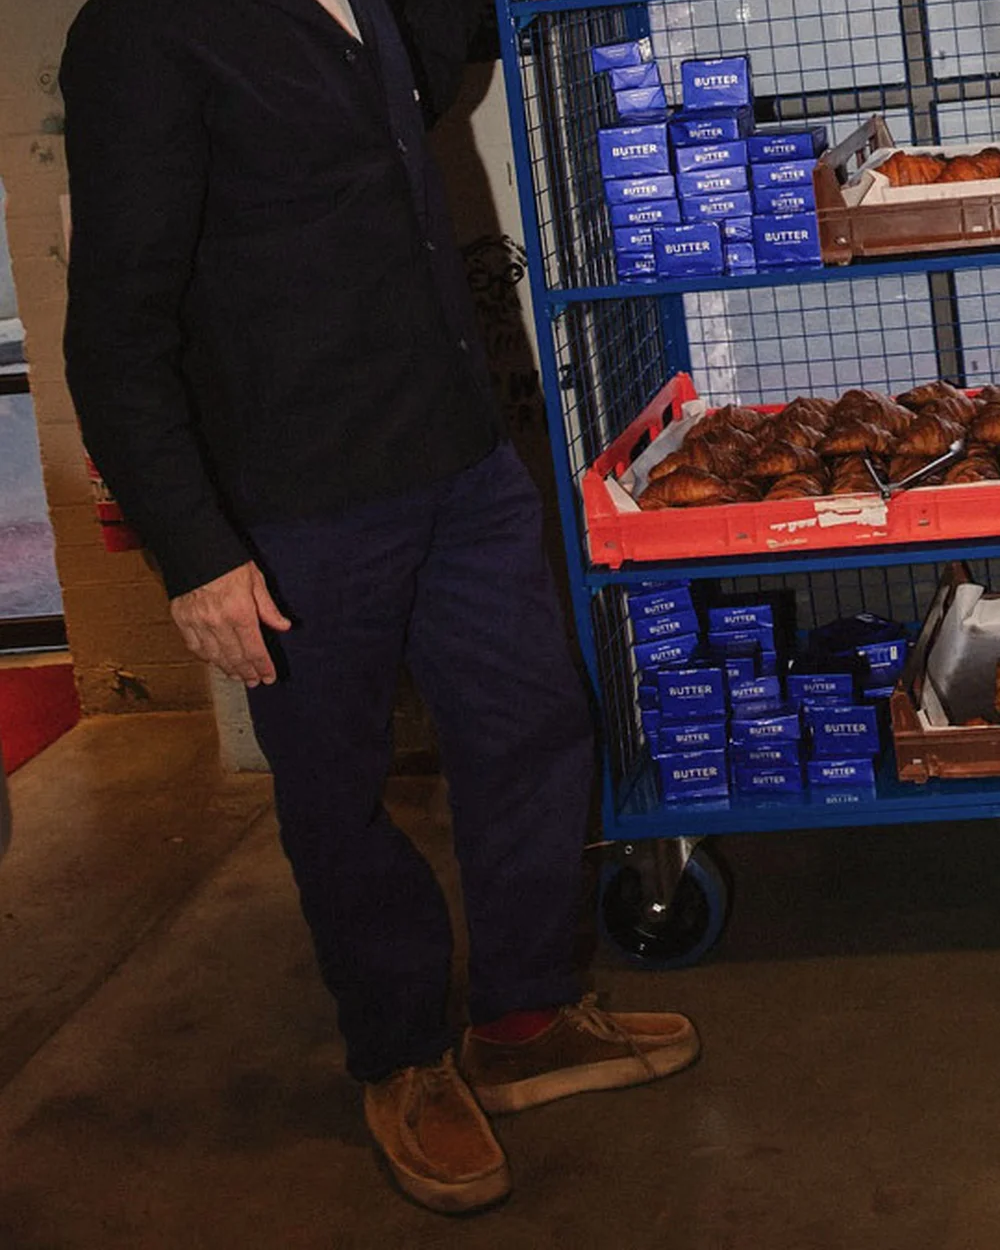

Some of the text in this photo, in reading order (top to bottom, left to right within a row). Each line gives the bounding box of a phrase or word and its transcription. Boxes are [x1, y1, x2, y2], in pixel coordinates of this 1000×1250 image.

[694, 74, 738, 87] BUTTER
[689, 128, 724, 137] BUTTER
[612, 144, 658, 156] BUTTER
[763, 144, 797, 153] BUTTER
[694, 151, 730, 161] BUTTER
[770, 169, 805, 180] BUTTER
[697, 179, 732, 190] BUTTER
[623, 185, 658, 196] BUTTER
[701, 202, 735, 212] BUTTER
[771, 197, 805, 207] BUTTER
[629, 210, 663, 221] BUTTER
[631, 234, 652, 244] BUTT
[764, 230, 809, 242] BUTTER
[665, 241, 711, 254] BUTTER
[644, 602, 675, 614] BUTTER
[724, 614, 756, 623] BUTTER
[649, 622, 680, 634] BUTTER
[650, 648, 681, 661] BUTTER
[669, 685, 712, 696] BUTTER
[732, 687, 765, 696] BUTTER
[803, 683, 836, 691] BUTTER
[750, 725, 784, 735] BUTTER
[824, 723, 867, 733] BUTTER
[676, 733, 710, 742] BUTTER
[673, 766, 718, 780] BUTTER
[822, 767, 856, 776] BUTTER
[753, 775, 785, 784] BUTTER
